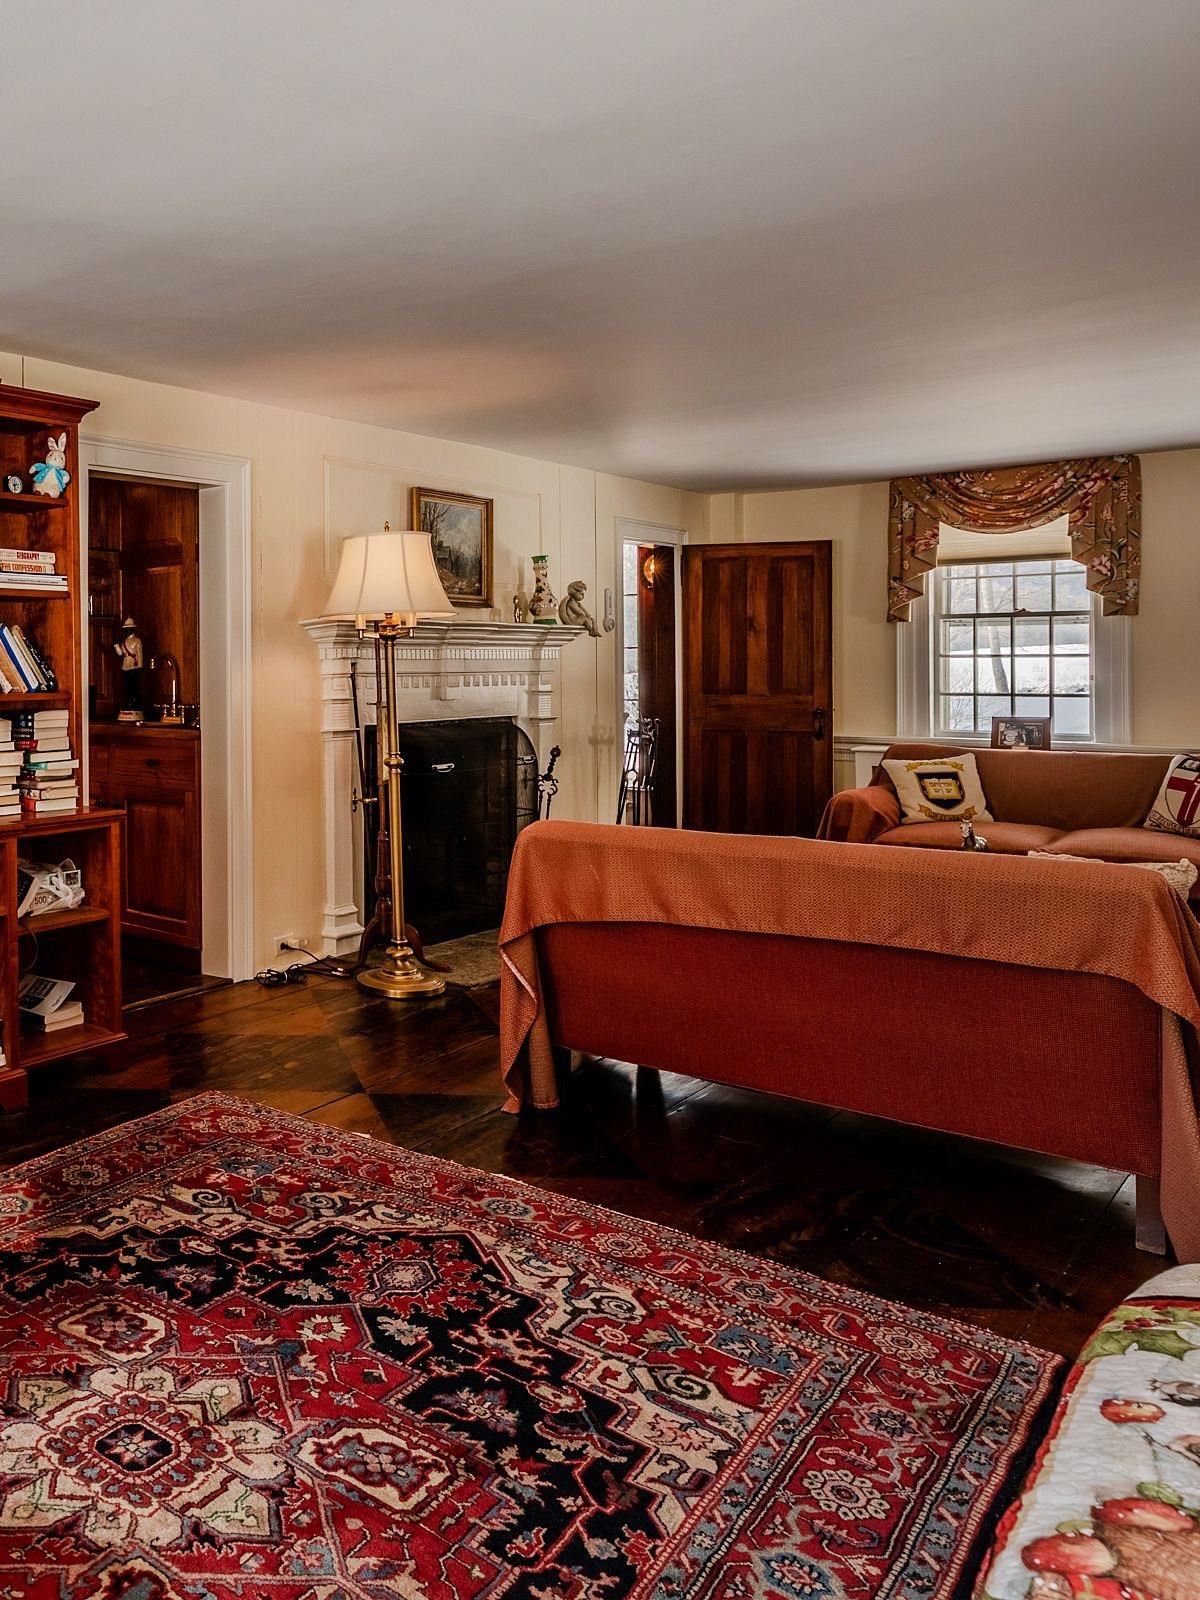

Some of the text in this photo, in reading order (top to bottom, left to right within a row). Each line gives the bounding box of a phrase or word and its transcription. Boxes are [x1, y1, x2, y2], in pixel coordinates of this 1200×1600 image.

[17, 552, 40, 560] GEOGRAPHY
[12, 564, 42, 572] CONFESSION
[34, 896, 46, 904] 500
